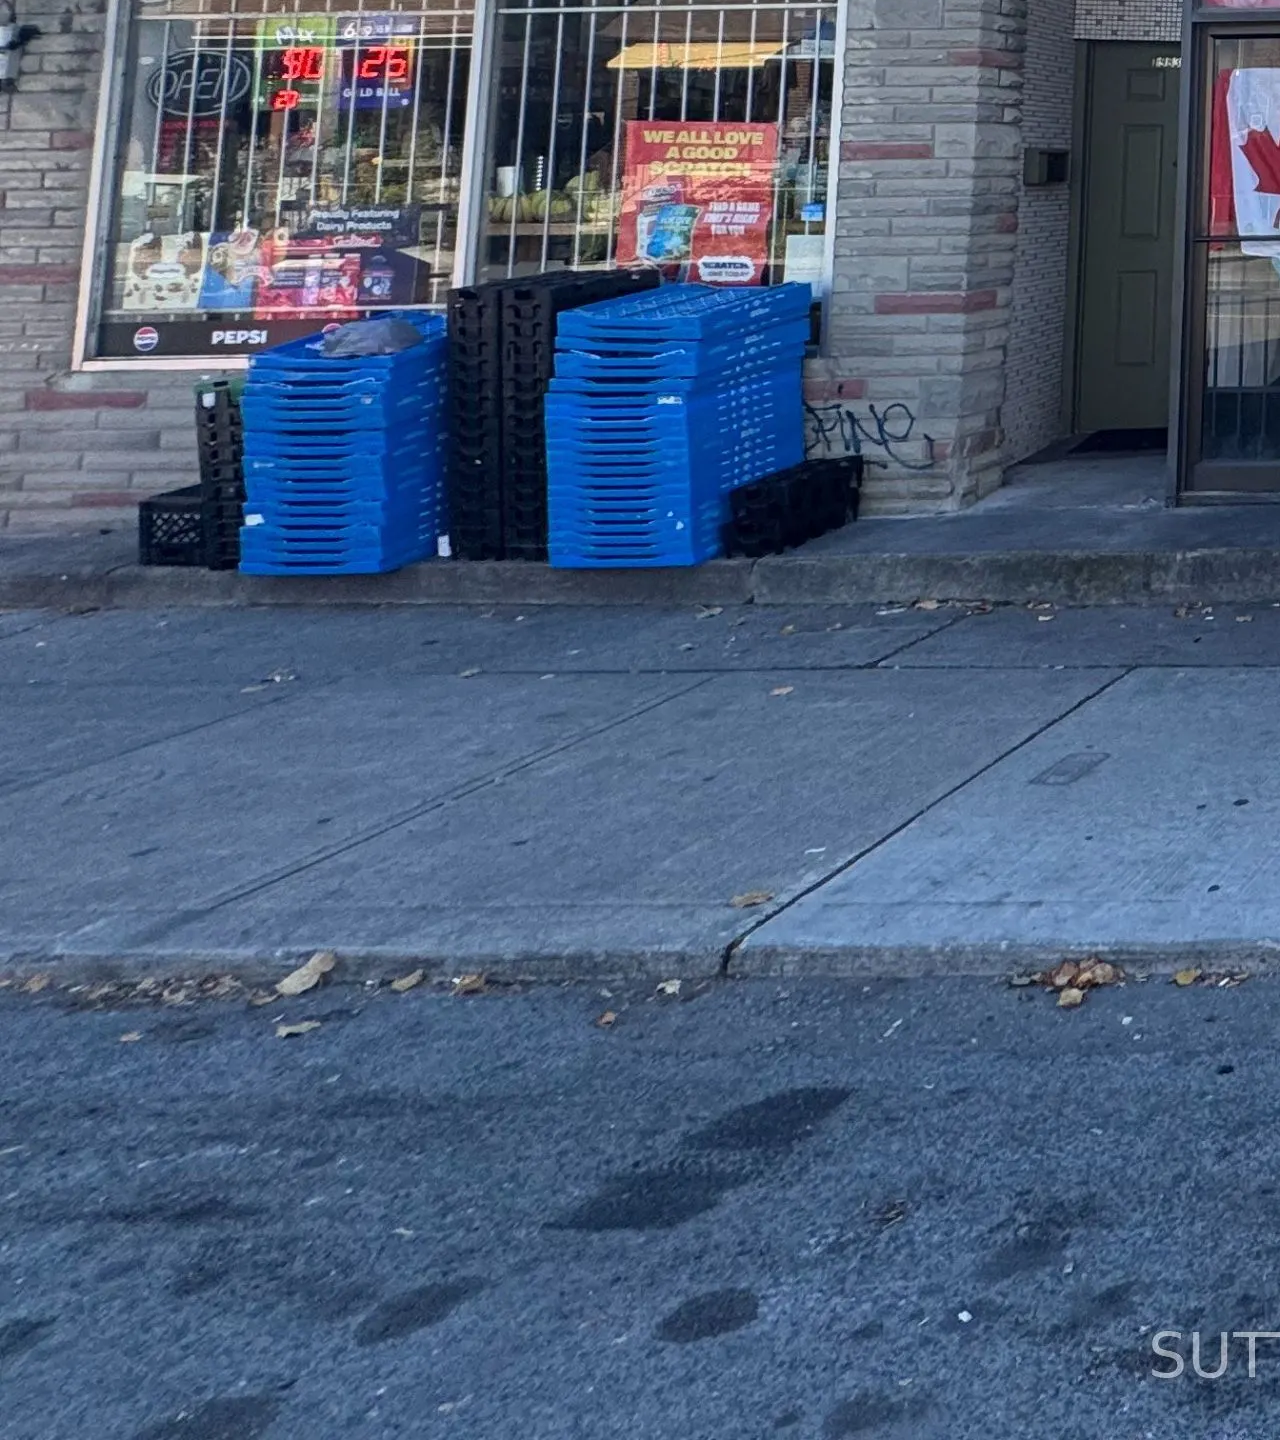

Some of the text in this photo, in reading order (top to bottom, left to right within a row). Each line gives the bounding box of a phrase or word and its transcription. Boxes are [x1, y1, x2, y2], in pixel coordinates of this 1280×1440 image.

[154, 57, 241, 100] OPEN
[343, 86, 372, 98] GLD
[643, 130, 764, 145] WE ALL LOVE
[666, 146, 738, 160] A GOOD
[211, 329, 268, 345] PEPSI
